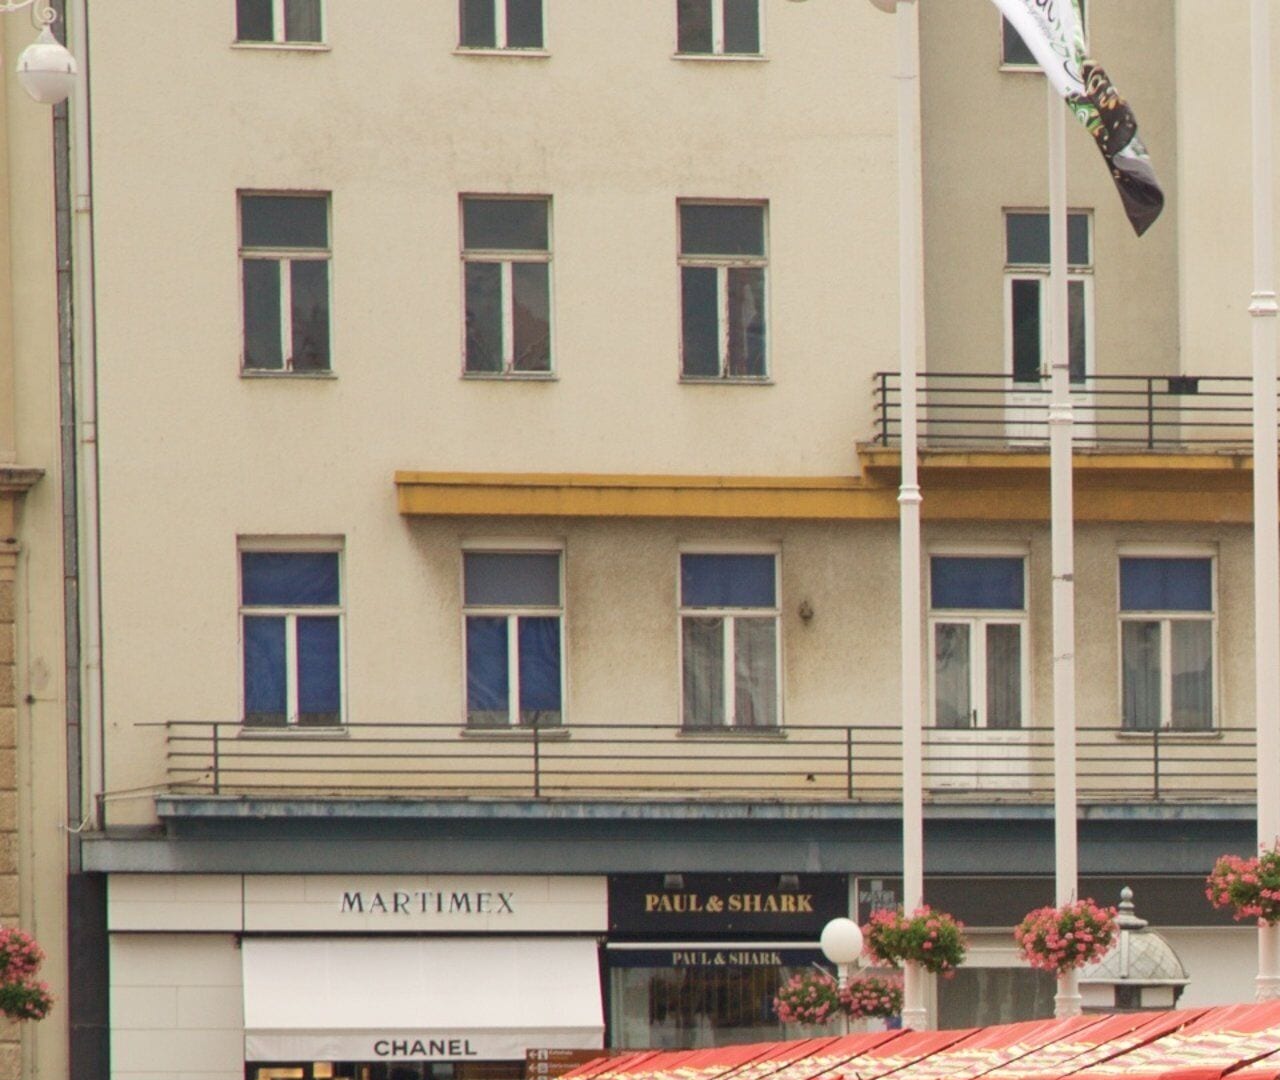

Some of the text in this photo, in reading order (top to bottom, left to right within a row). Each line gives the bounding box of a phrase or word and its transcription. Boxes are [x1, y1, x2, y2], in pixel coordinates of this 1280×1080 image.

[341, 892, 514, 914] MARTIMEX
[645, 894, 813, 912] PAUL & SHARK
[672, 952, 782, 965] PAUL & SHARK
[374, 1040, 477, 1056] CHANEL
